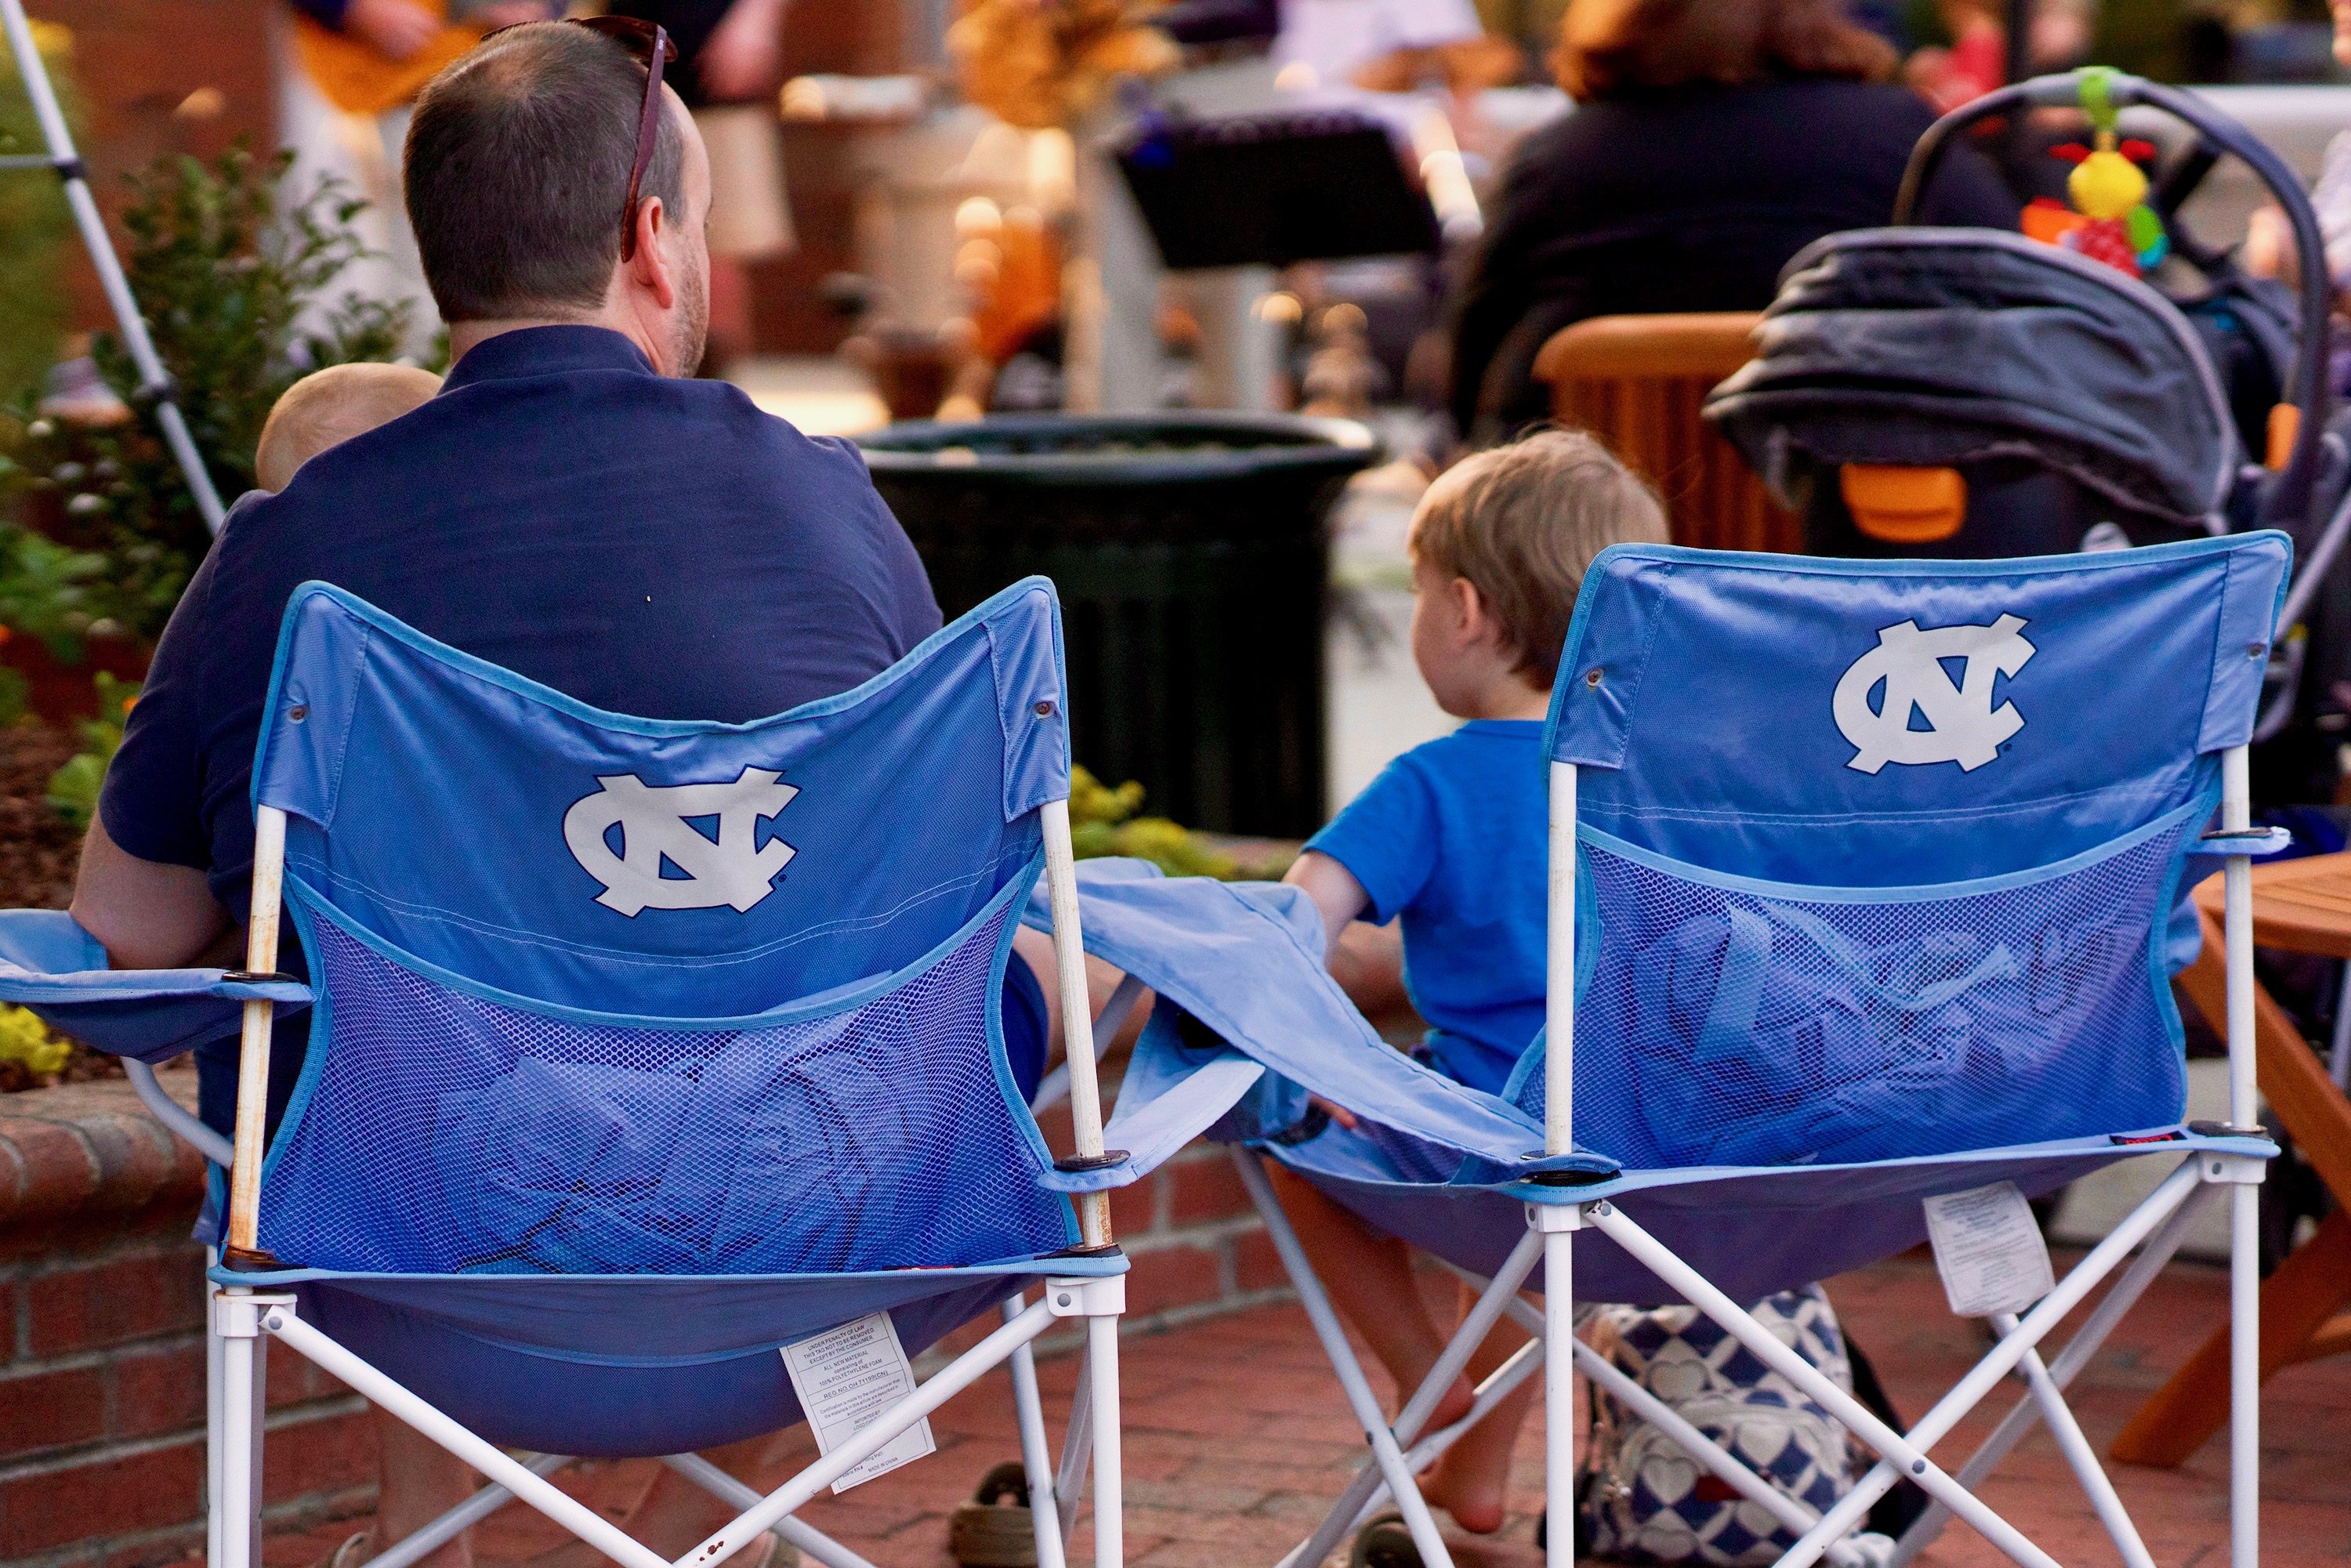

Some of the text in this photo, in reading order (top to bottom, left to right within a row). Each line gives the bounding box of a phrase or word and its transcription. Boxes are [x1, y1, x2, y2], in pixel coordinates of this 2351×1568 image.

[850, 1328, 874, 1340] REMOVED
[808, 1341, 824, 1350] UNDER
[825, 1332, 846, 1343] PENALTY
[810, 1353, 828, 1363] EXCEPT
[846, 1335, 873, 1349] CONSUMER
[846, 1350, 868, 1362] MATERIAL
[832, 1364, 868, 1382] POLYETHYLENE
[834, 1361, 857, 1374] consisting
[854, 1412, 875, 1425] IMPORTED
